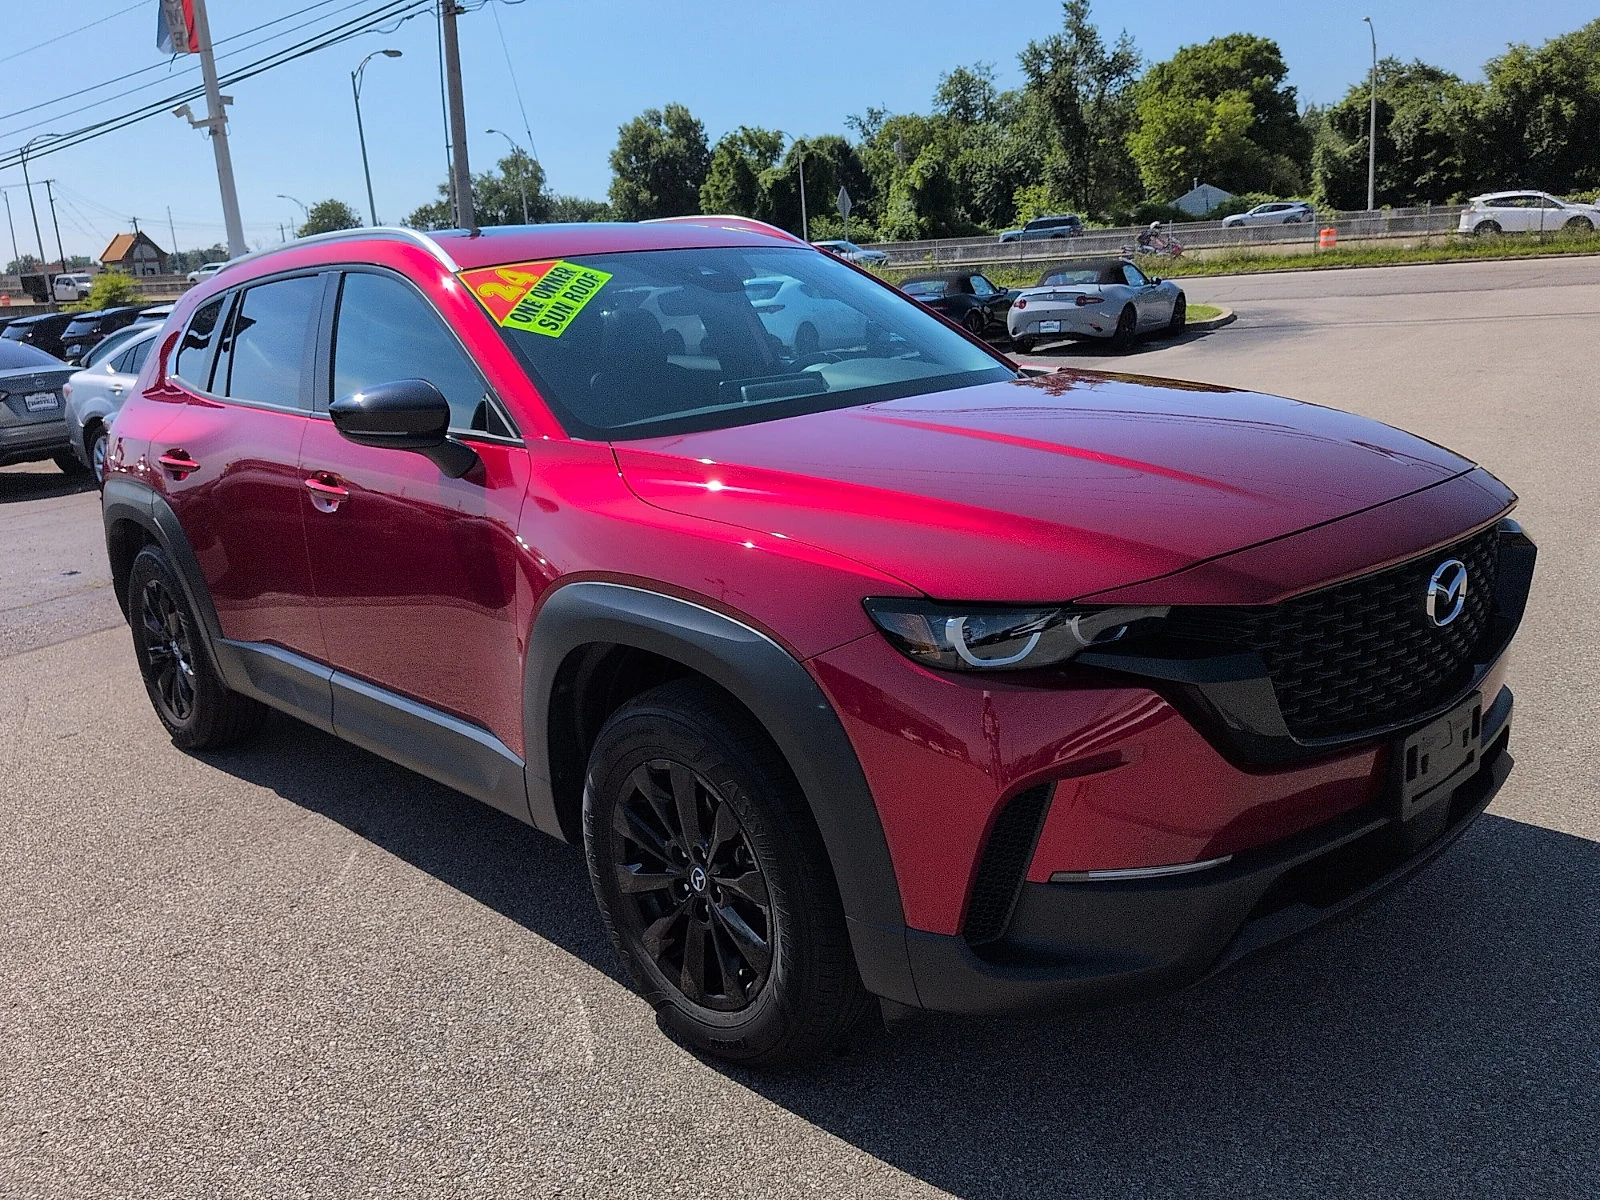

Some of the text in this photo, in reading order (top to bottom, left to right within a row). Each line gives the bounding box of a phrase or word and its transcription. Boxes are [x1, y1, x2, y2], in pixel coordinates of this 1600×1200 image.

[477, 268, 539, 302] 24
[509, 266, 577, 324] ONE OWNER
[538, 272, 600, 331] SUN ROOF
